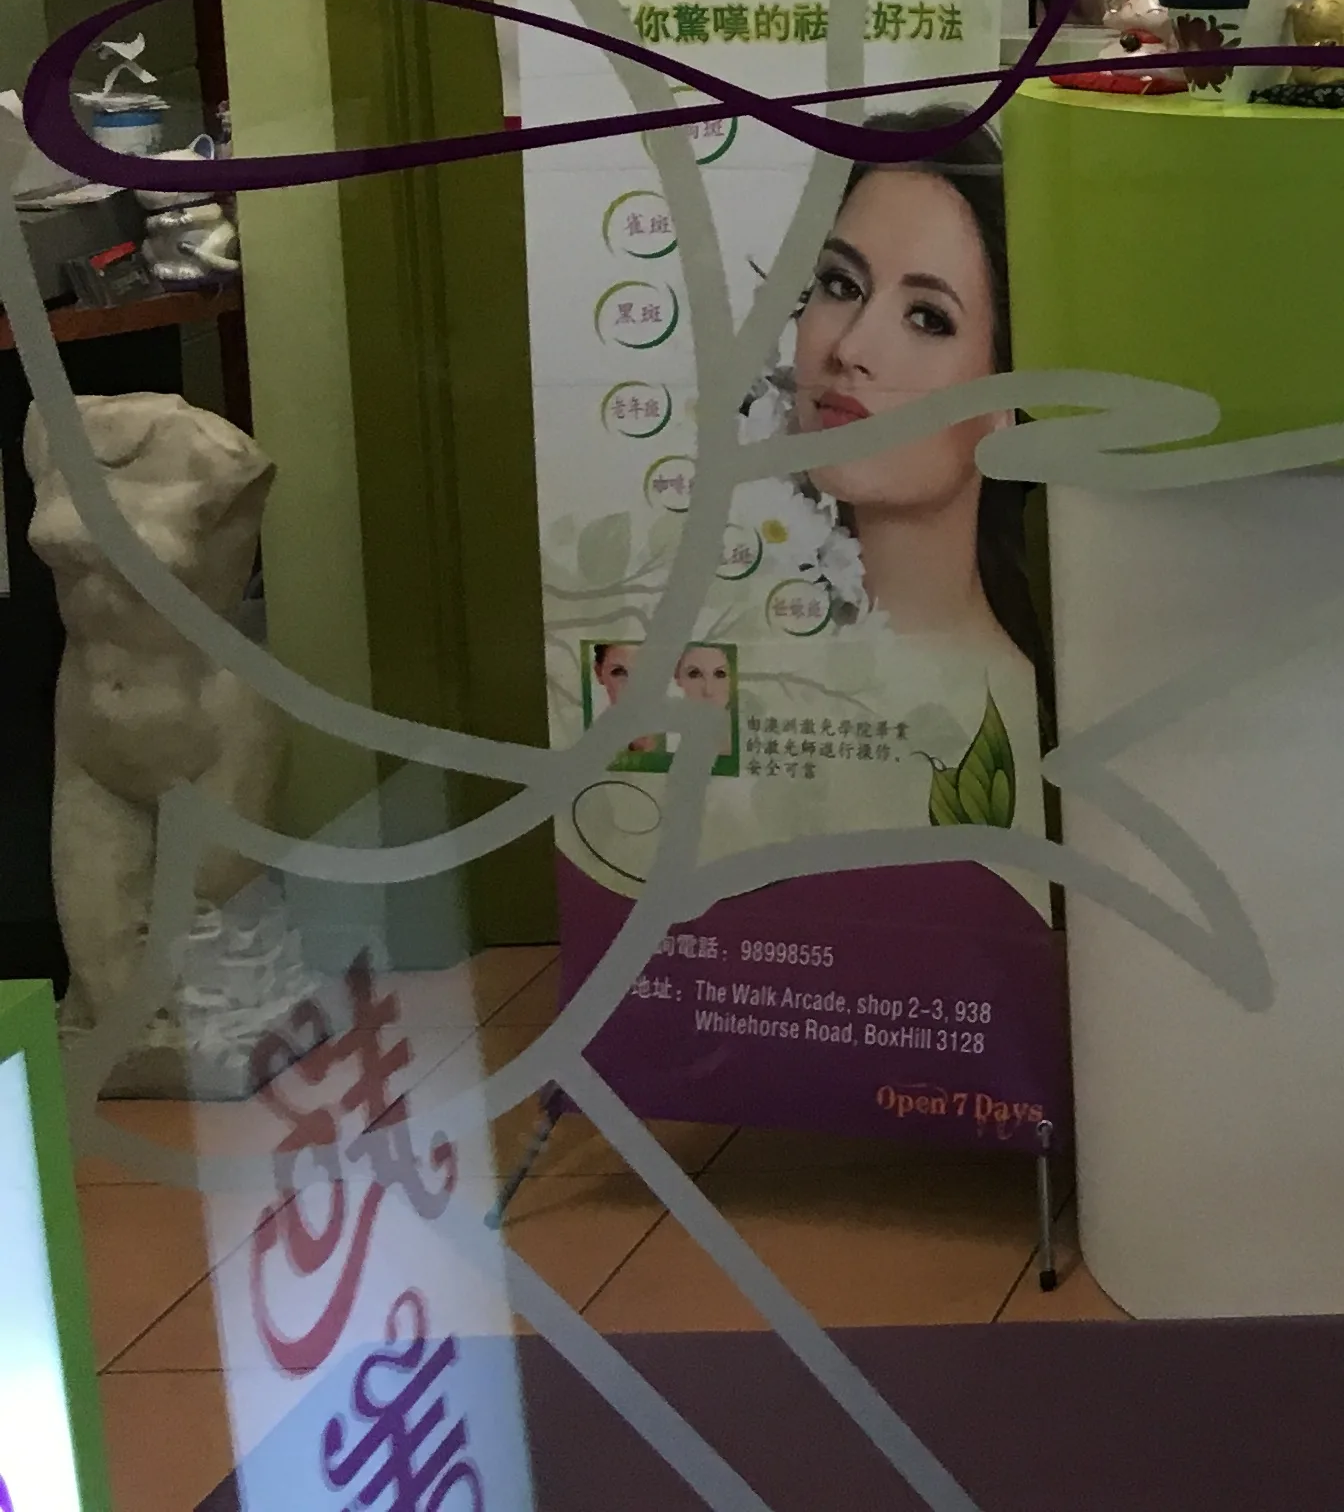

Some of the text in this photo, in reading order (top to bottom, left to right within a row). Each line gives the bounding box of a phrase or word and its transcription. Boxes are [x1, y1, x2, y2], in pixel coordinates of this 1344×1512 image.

[740, 940, 836, 969] 98998555
[695, 978, 727, 1005] The
[732, 982, 776, 1010] Walk
[781, 987, 852, 1015] Arcade,
[857, 992, 904, 1022] shop
[954, 998, 993, 1026] 938
[694, 1009, 986, 1055] Whitehorse Road, BoxHill 3128
[875, 1084, 1045, 1130] Open 7 Days
